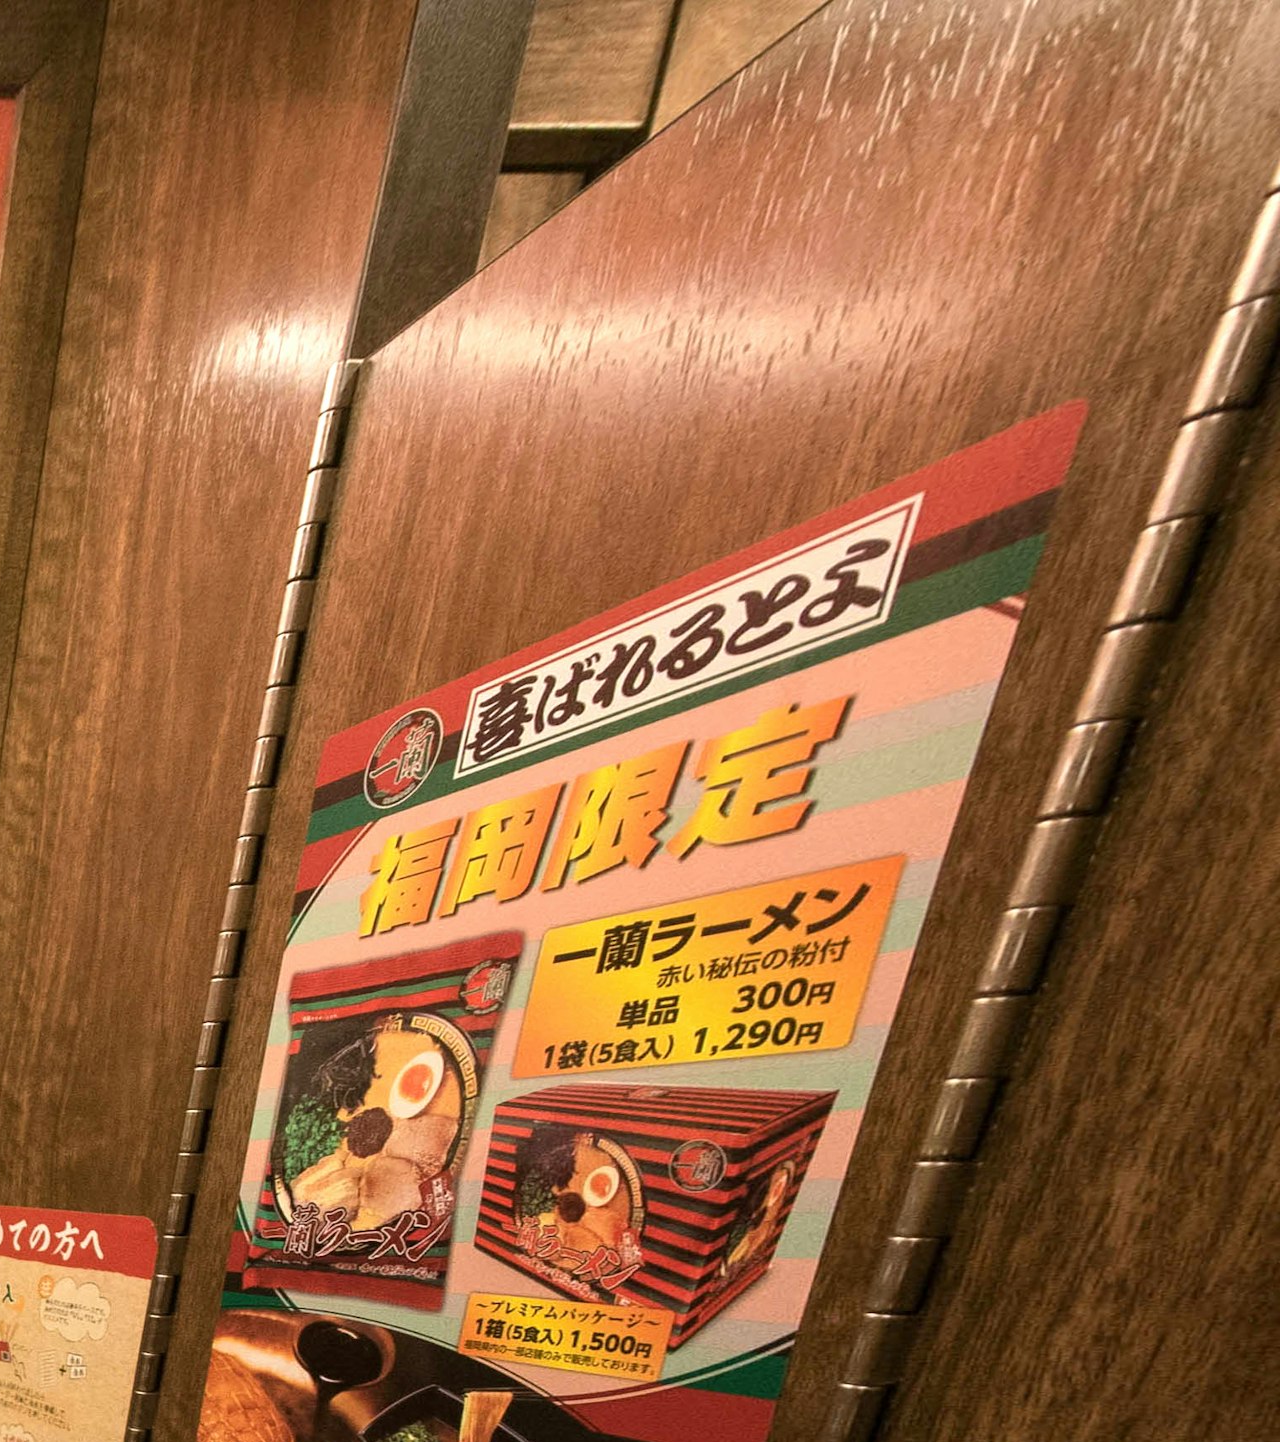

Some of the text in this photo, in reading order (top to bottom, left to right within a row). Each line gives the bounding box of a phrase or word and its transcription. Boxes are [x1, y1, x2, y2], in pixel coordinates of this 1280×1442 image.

[358, 694, 855, 938] 福岡限定
[552, 882, 872, 975] 一蘭ラーメン
[656, 936, 851, 989] 赤い秘伝の粉付
[616, 977, 836, 1030] 単品 300円
[543, 1017, 824, 1070] 1袋(5食入) 1,290円
[260, 1203, 452, 1261] 一蘭ラーメン
[464, 1339, 656, 1376] 福岡県内の一部店舗のみで販売しております。
[474, 1318, 653, 1359] 1箱(5食入) 1,500円
